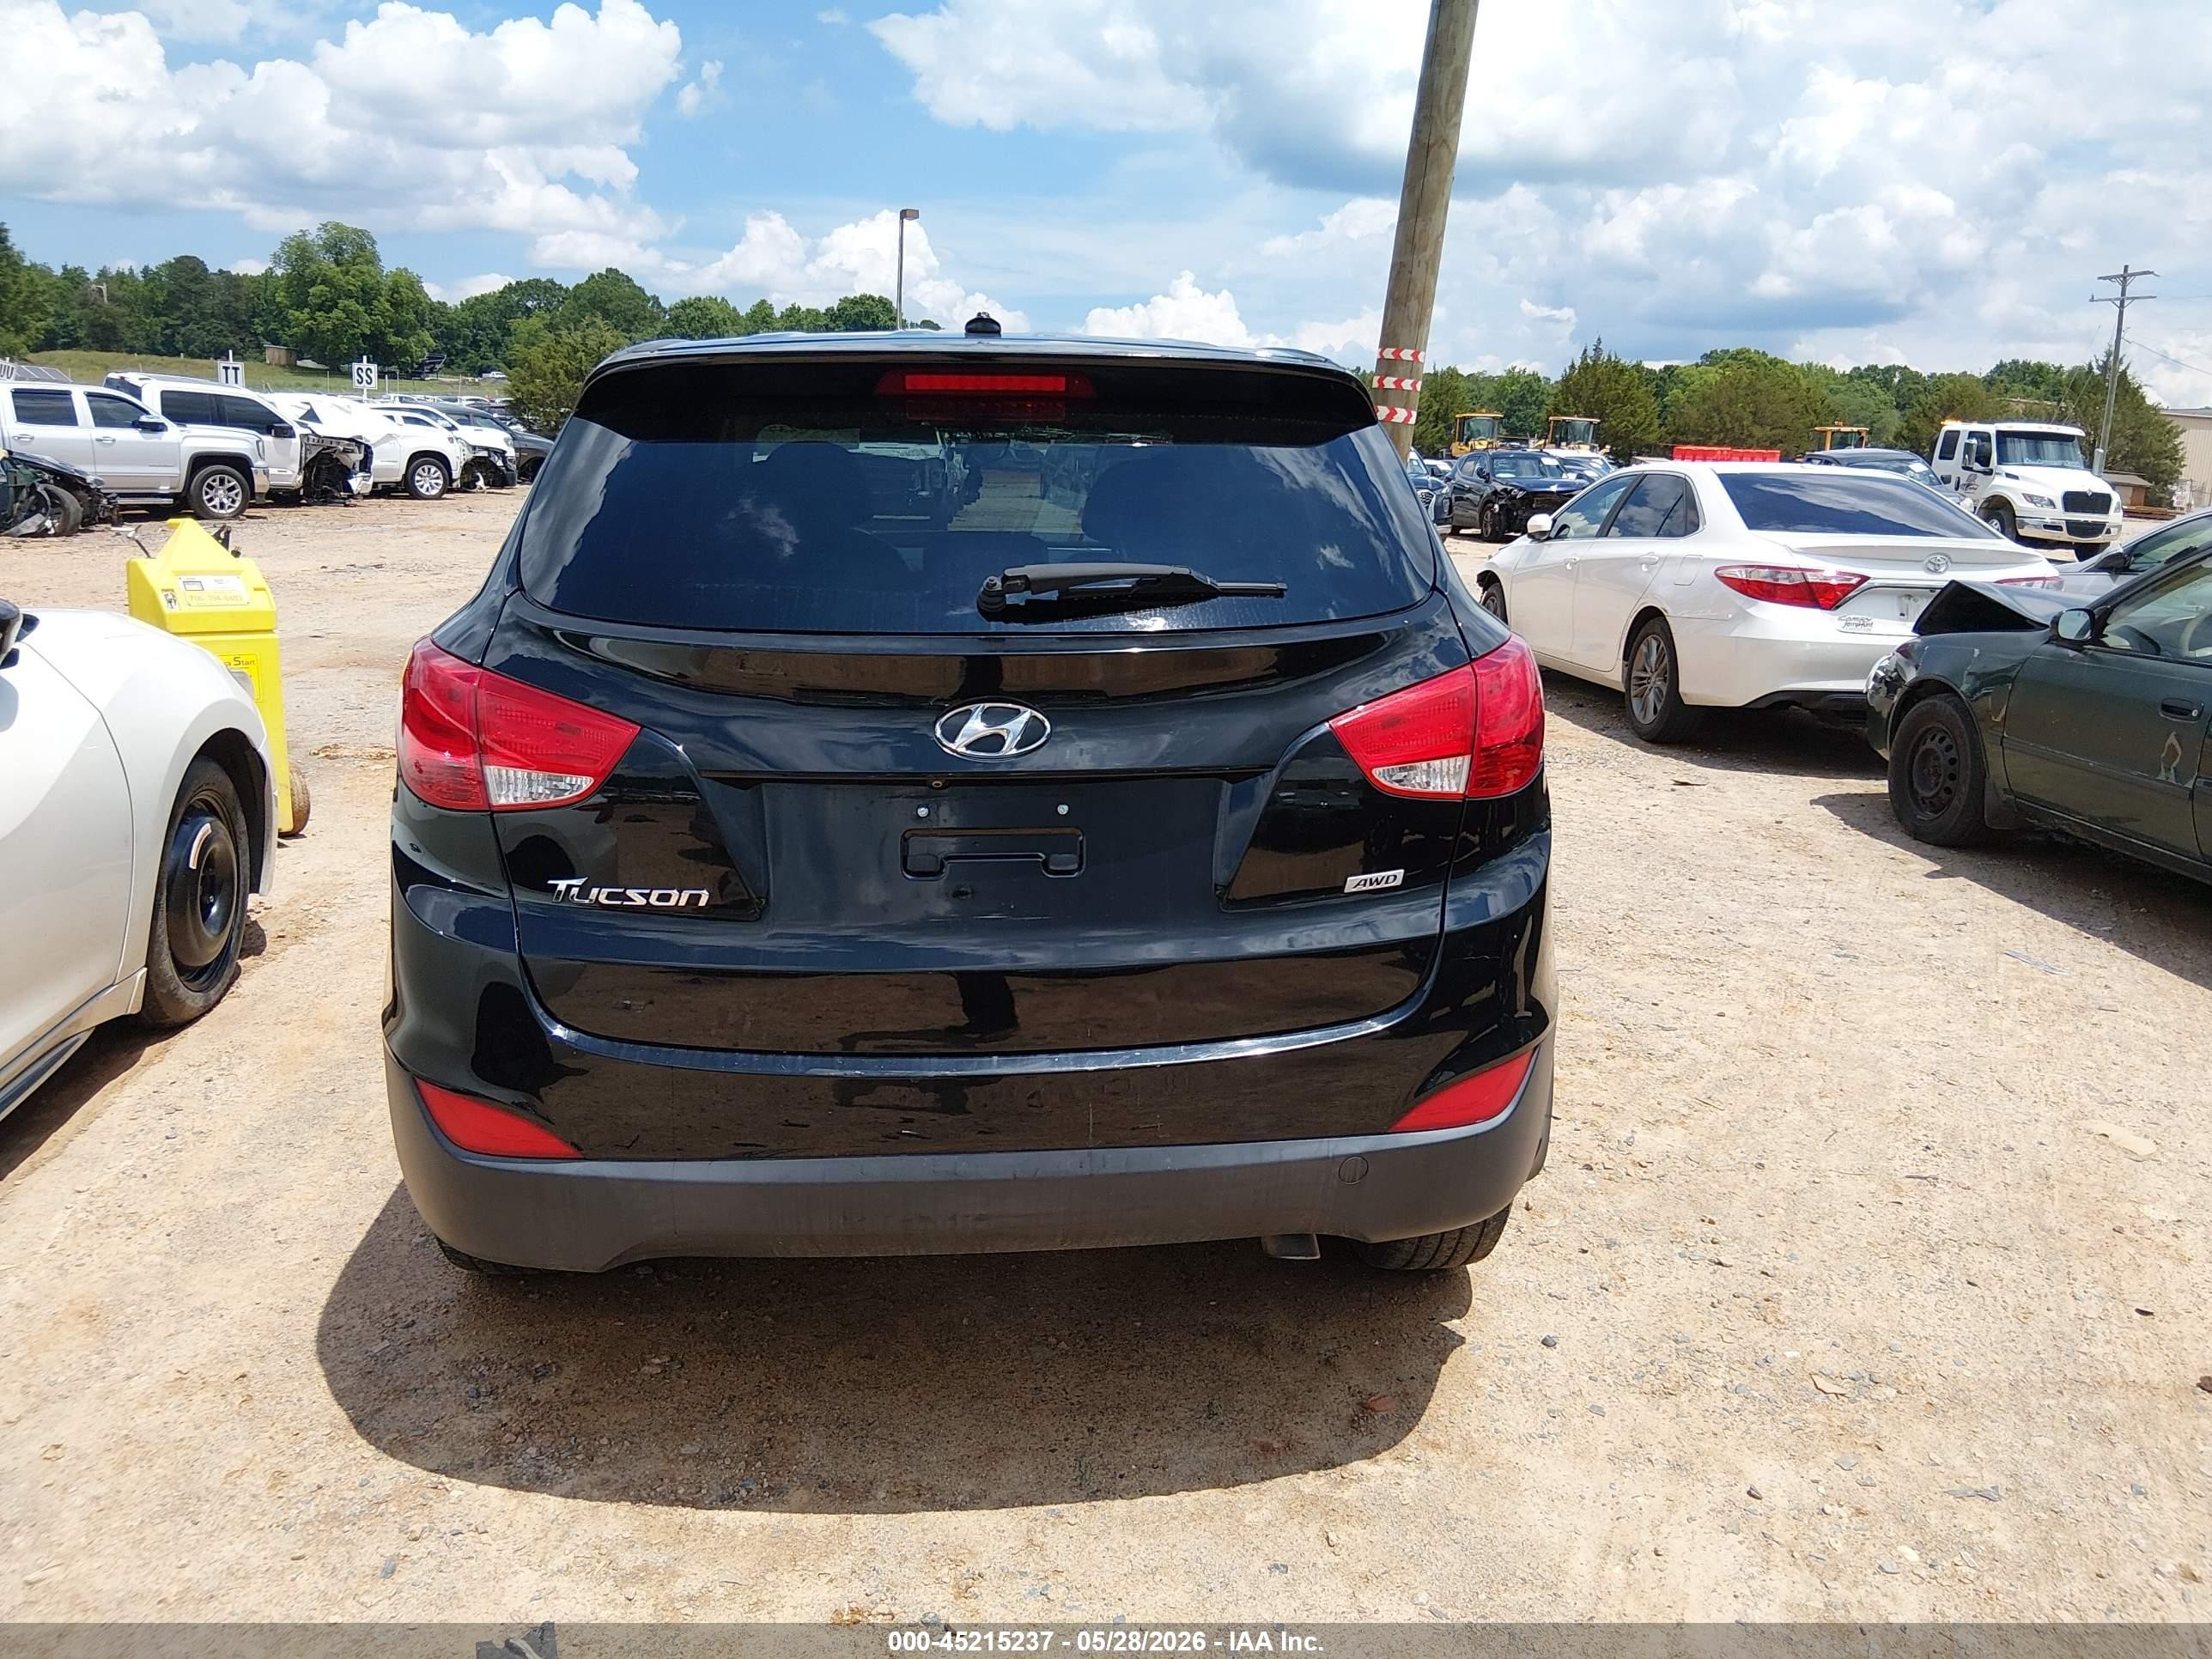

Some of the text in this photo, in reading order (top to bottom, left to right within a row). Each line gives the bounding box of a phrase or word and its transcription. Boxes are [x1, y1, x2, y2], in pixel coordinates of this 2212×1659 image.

[222, 366, 240, 384] TT
[356, 367, 373, 385] SS
[233, 656, 256, 666] Start
[1352, 874, 1398, 890] AWD
[546, 877, 710, 907] Tucson
